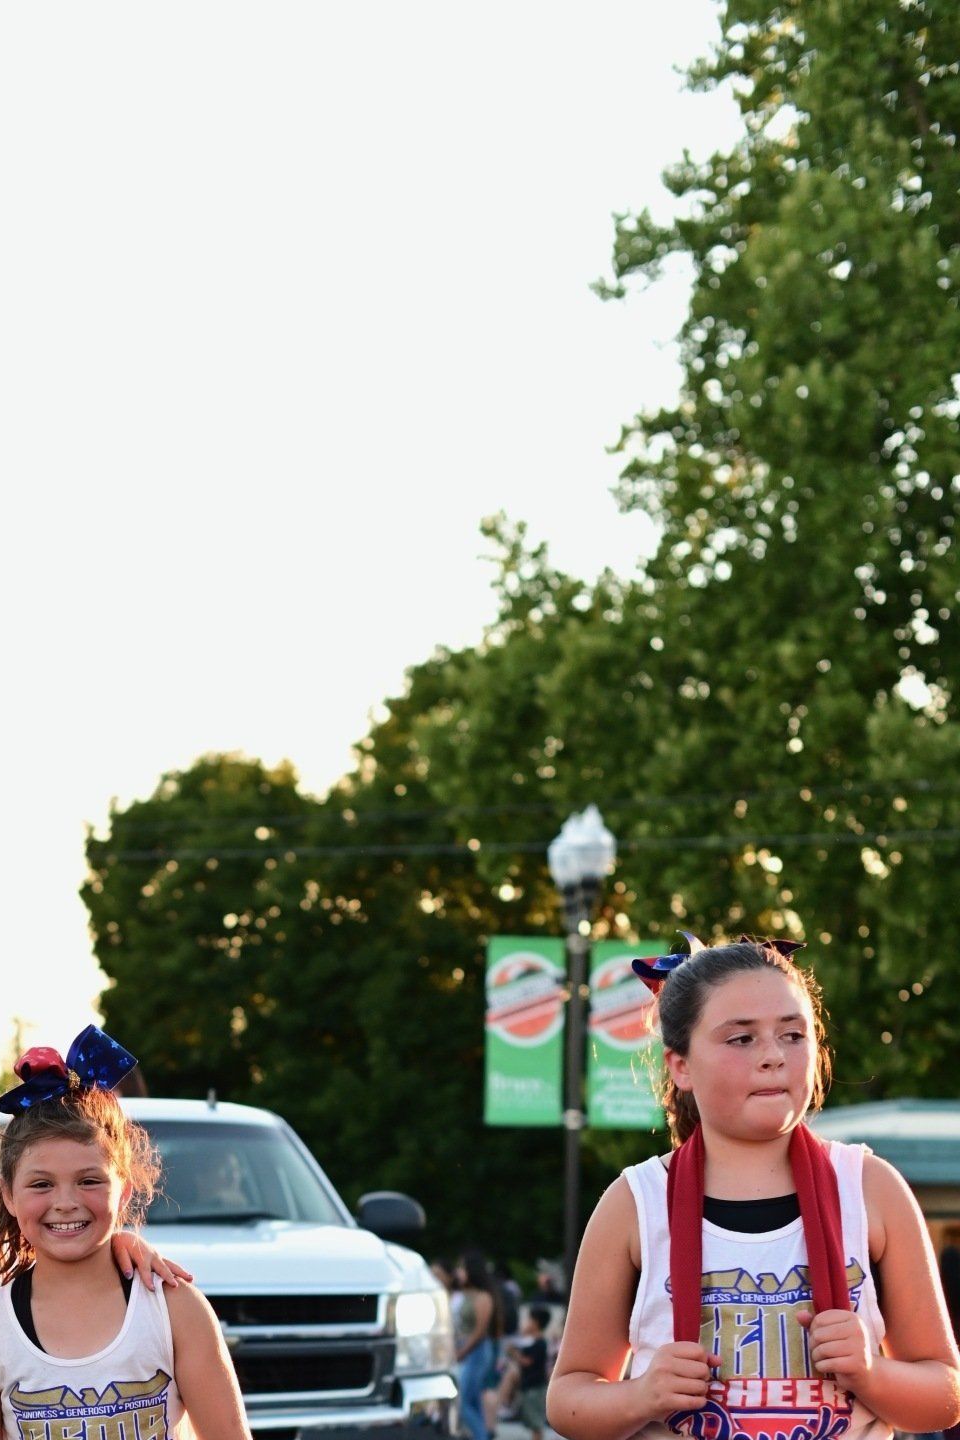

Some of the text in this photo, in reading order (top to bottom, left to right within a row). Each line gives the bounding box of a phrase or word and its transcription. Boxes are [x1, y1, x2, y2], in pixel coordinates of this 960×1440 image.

[701, 1292, 731, 1303] DNESS
[741, 1290, 800, 1304] GENEROSITY
[21, 1395, 162, 1419] KINDNESS GENEROSITY POSITIVITY
